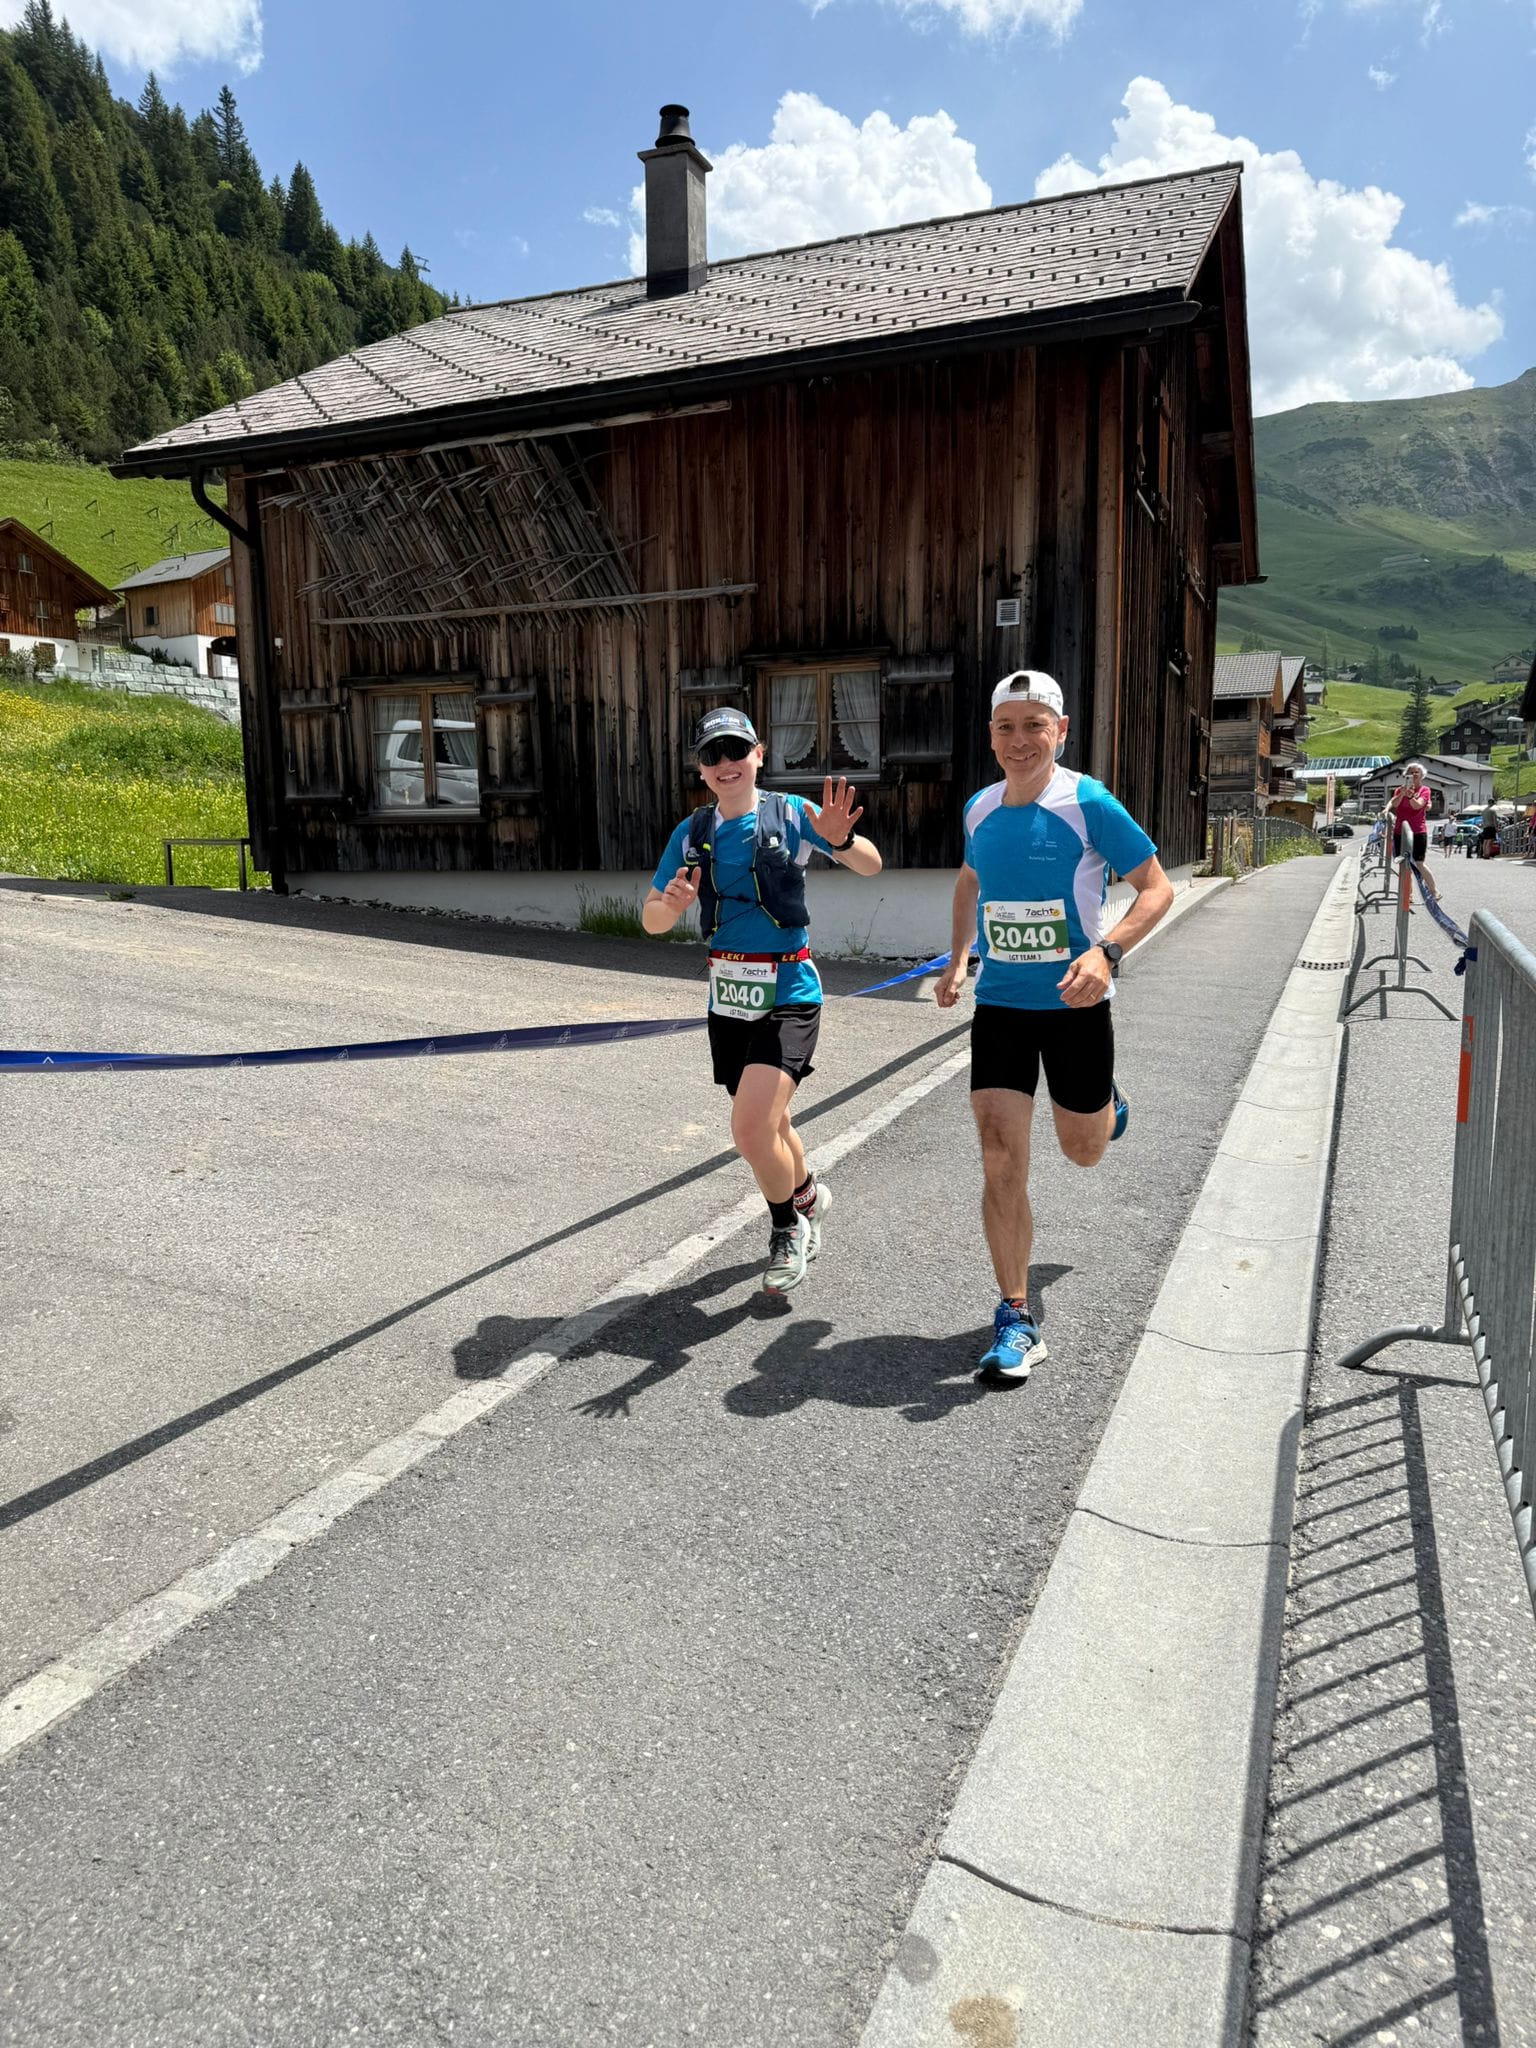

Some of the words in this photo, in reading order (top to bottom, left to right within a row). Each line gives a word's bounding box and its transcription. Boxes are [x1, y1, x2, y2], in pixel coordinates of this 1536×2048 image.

[993, 926, 1056, 948] 2040
[721, 952, 745, 960] LEKI
[742, 967, 768, 976] 7acht
[719, 982, 765, 1007] 2040
